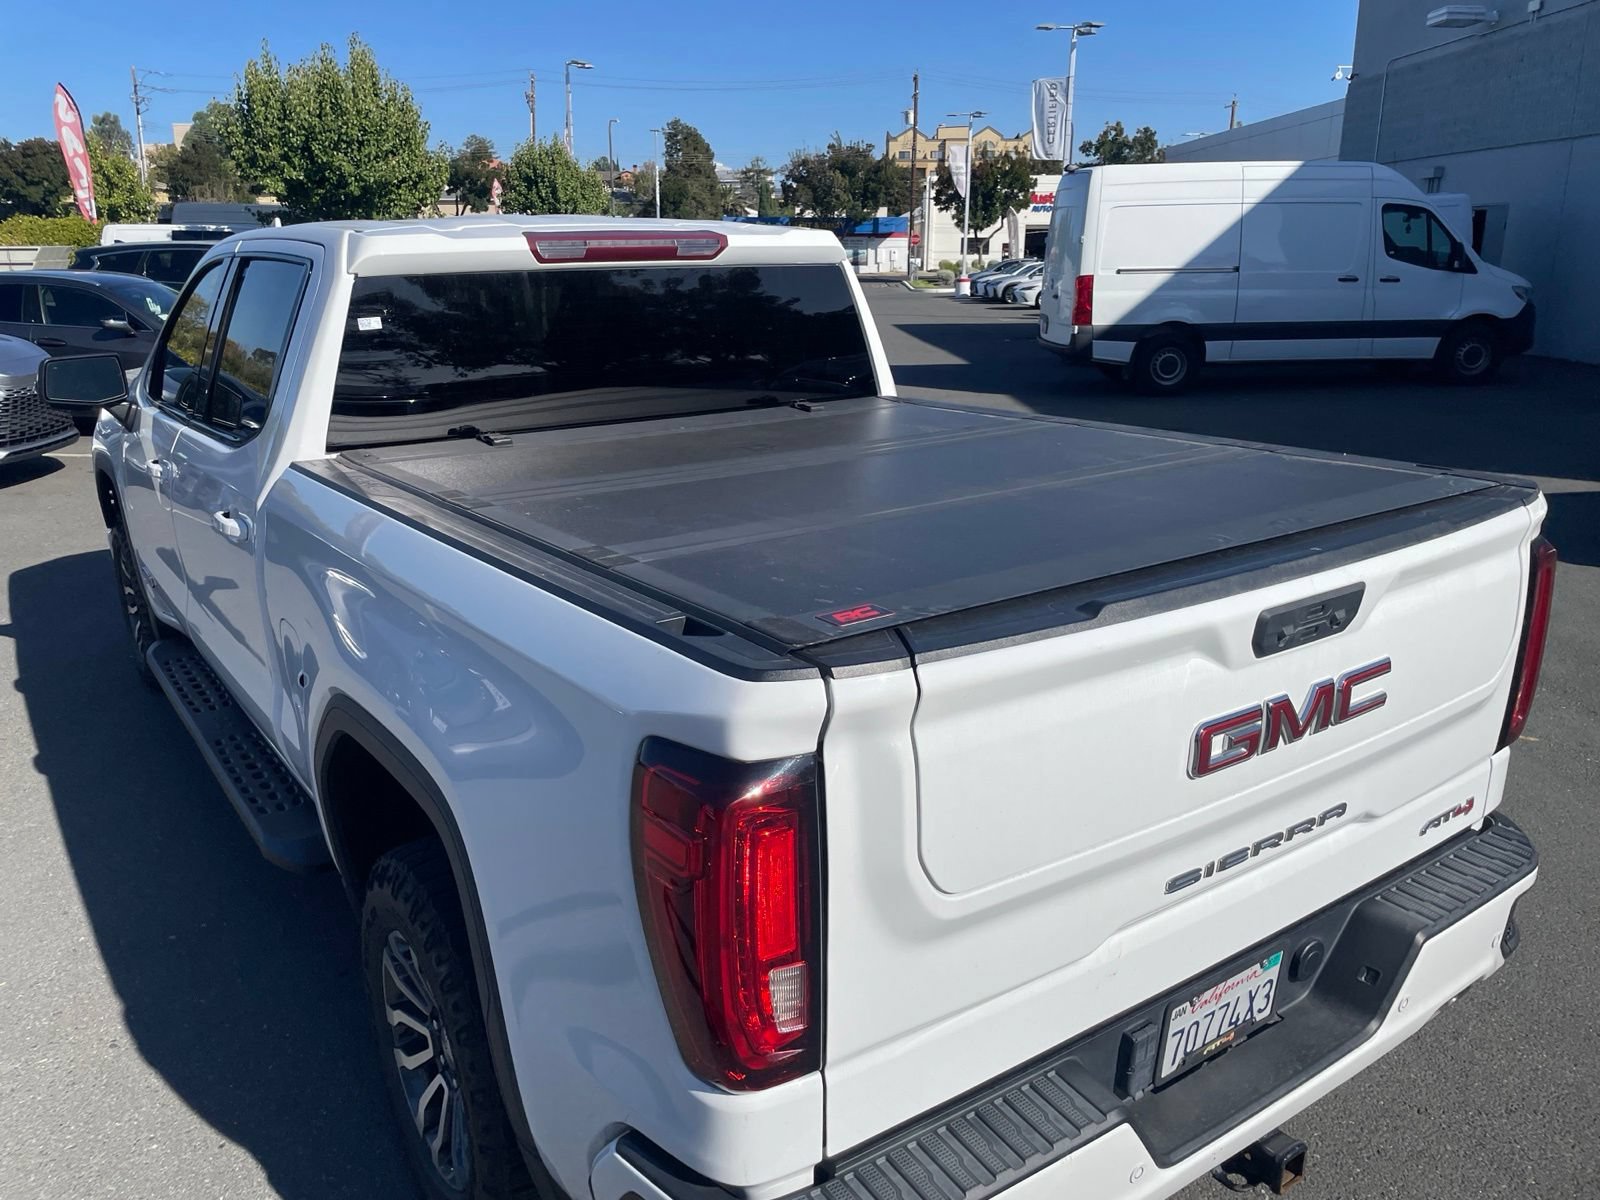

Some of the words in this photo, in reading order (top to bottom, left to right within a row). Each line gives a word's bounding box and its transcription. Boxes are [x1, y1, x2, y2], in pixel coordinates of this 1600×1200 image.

[1187, 656, 1392, 779] GMC
[1163, 802, 1348, 895] SIERRA
[1419, 796, 1474, 837] AT4
[1170, 978, 1274, 1067] 70774X3
[1171, 1006, 1188, 1022] JAN
[1190, 969, 1262, 1015] California
